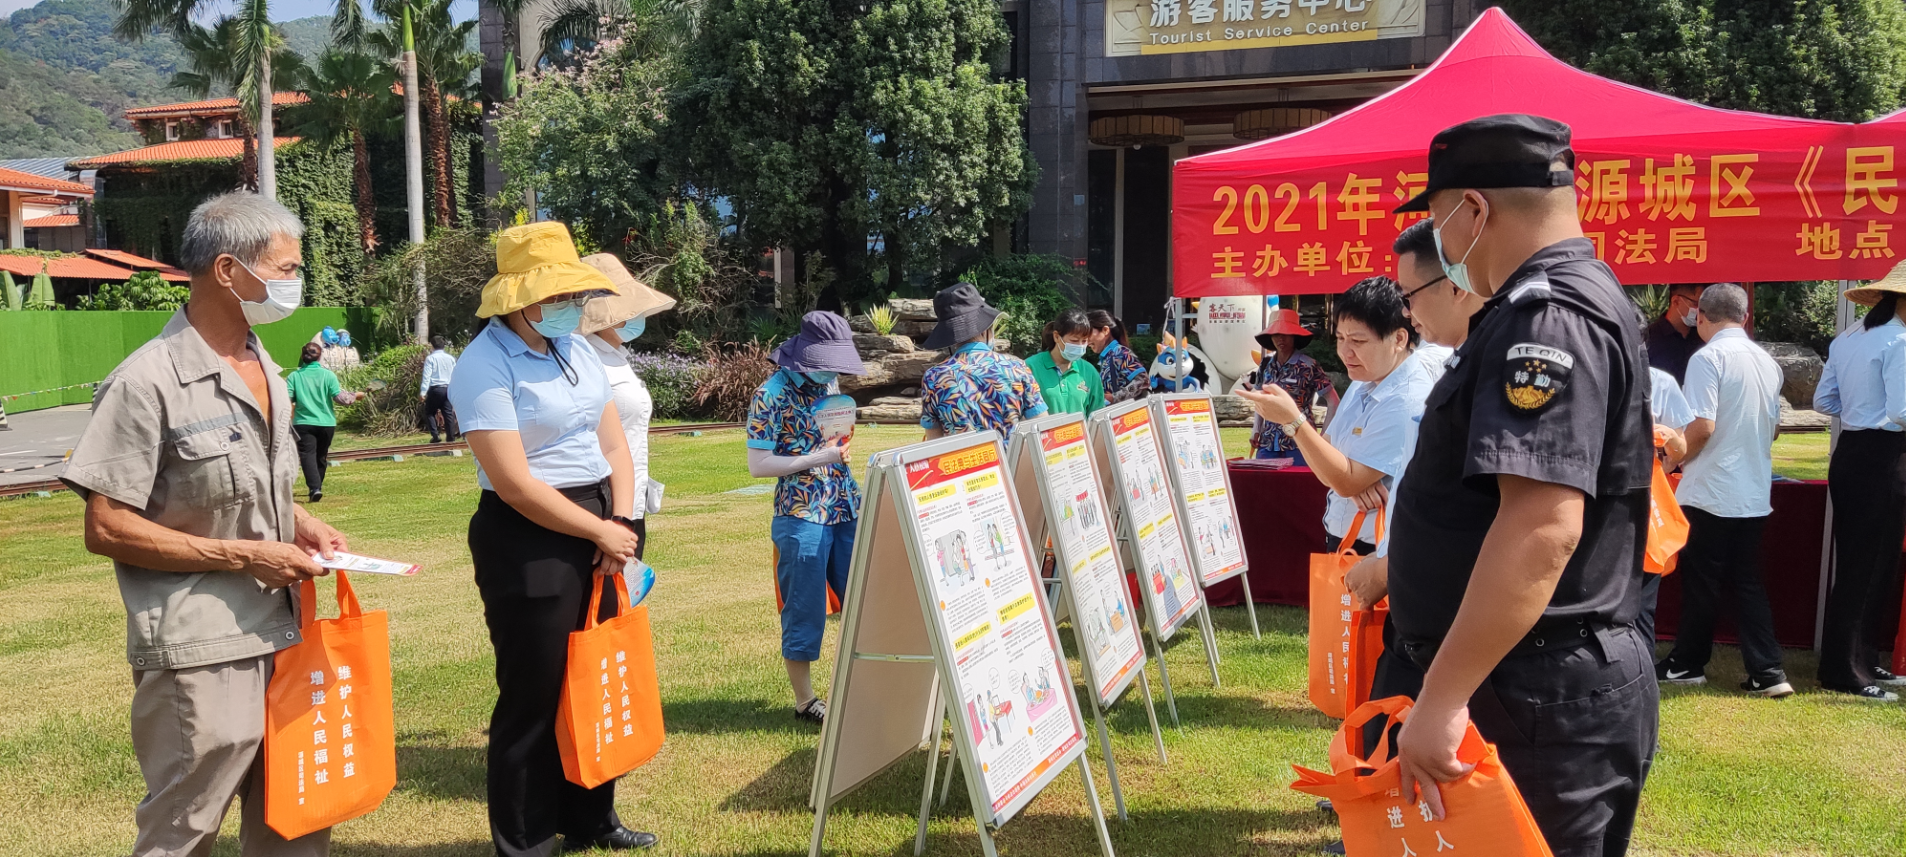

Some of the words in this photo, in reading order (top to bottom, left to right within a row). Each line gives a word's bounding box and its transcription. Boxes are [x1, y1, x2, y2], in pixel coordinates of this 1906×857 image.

[1149, 29, 1212, 46] Tourist
[1224, 25, 1293, 41] Service
[1305, 19, 1369, 35] Center
[1795, 220, 1896, 260] 地点
[1515, 346, 1534, 356] TE
[310, 670, 329, 786] 增进人民福祉
[337, 665, 355, 779] 维护人民权益
[600, 657, 614, 745] 增进人民福祉
[615, 650, 634, 738] 维护人民权益
